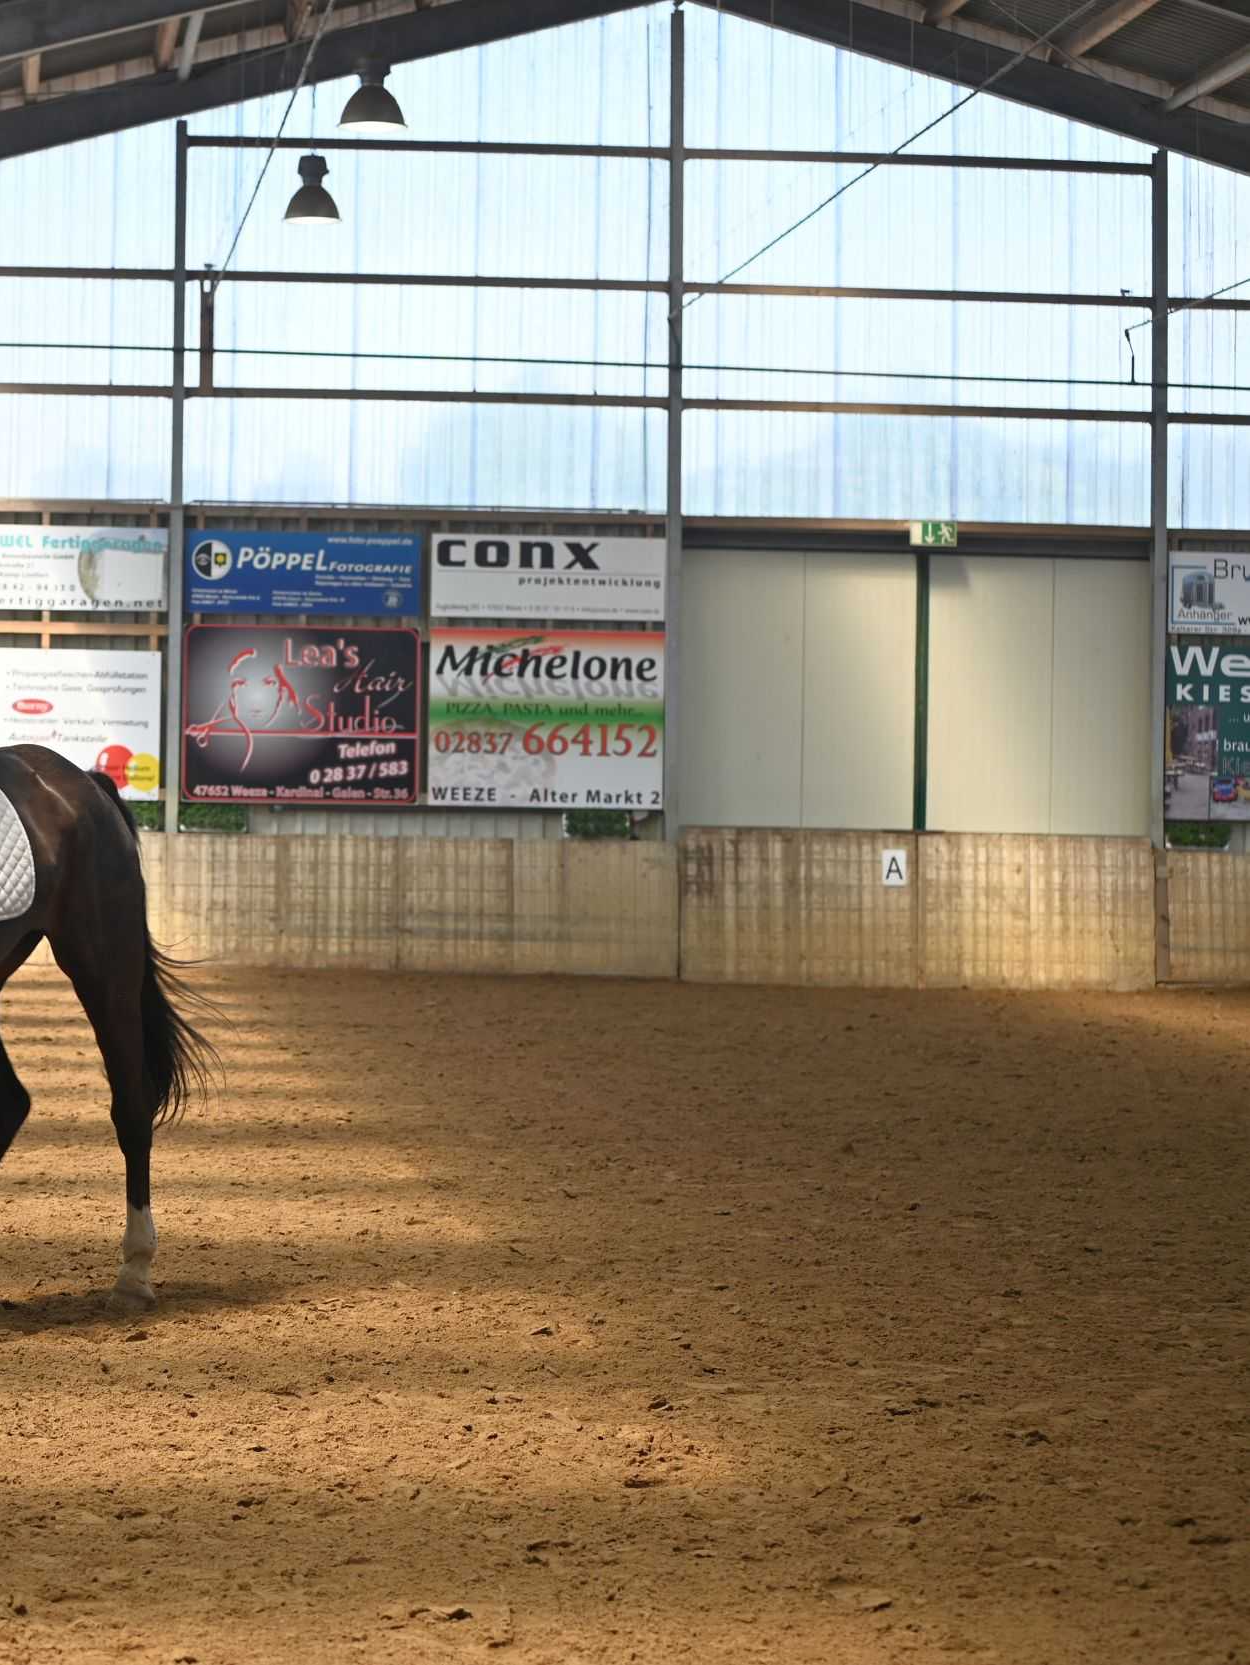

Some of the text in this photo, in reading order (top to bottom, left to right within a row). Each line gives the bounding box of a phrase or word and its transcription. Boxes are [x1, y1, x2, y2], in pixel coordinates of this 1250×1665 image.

[328, 561, 413, 574] FOTOGRAFIE
[518, 576, 661, 589] projektentwicklung
[285, 637, 360, 668] Lea's
[435, 644, 658, 682] Michelone
[333, 659, 413, 704] Hair
[301, 694, 405, 733] Studio
[503, 703, 552, 716] PASTA
[559, 703, 589, 717] und
[338, 741, 396, 759] Telefon
[434, 721, 658, 758] 02837 664152
[309, 768, 321, 784] 0
[323, 767, 343, 783] 28
[344, 764, 367, 782] 37
[378, 760, 409, 777] 583
[193, 785, 229, 797] 47652
[231, 786, 268, 797] Weeze
[276, 786, 324, 798] Kardinal
[432, 787, 497, 801] WEEZE
[529, 788, 578, 803] Alter
[585, 789, 643, 804] Markt
[651, 791, 661, 805] 2
[886, 856, 903, 880] A
